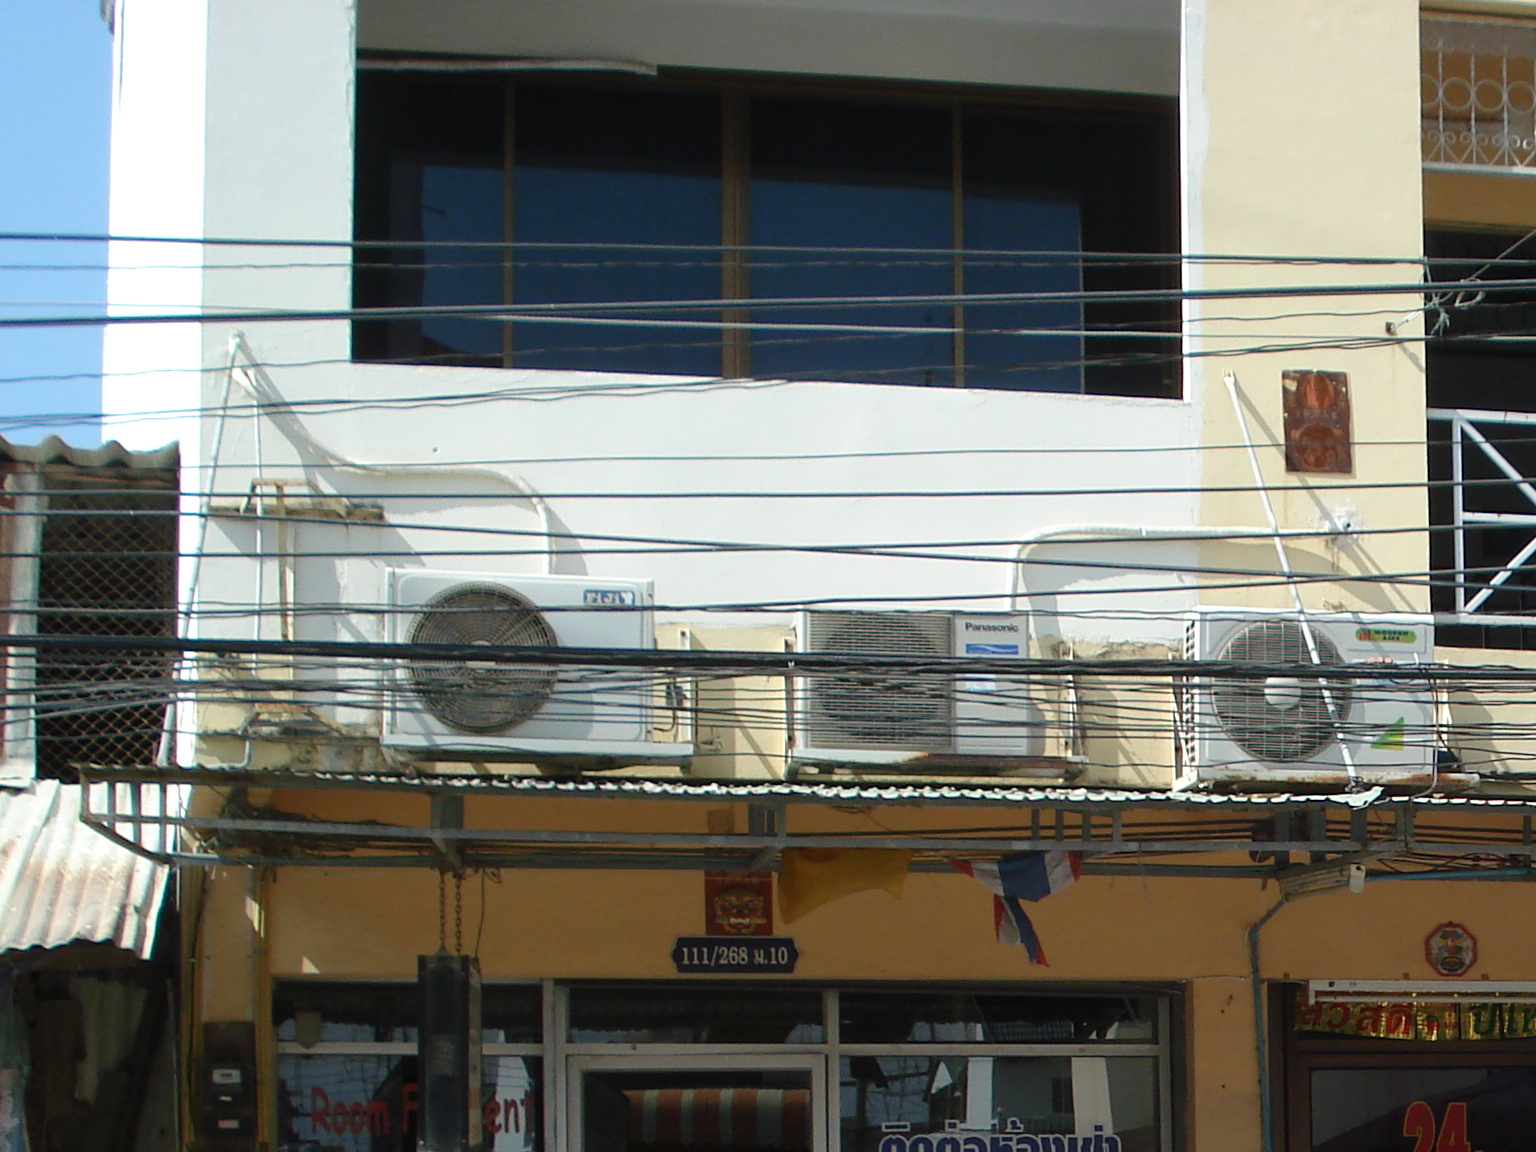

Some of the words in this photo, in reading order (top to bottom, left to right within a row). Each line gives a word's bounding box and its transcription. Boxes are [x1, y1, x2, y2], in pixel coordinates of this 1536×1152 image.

[965, 622, 1019, 633] Panasonic
[681, 946, 748, 966] 111/268
[754, 948, 788, 966] ม.10
[311, 1085, 390, 1136] Room
